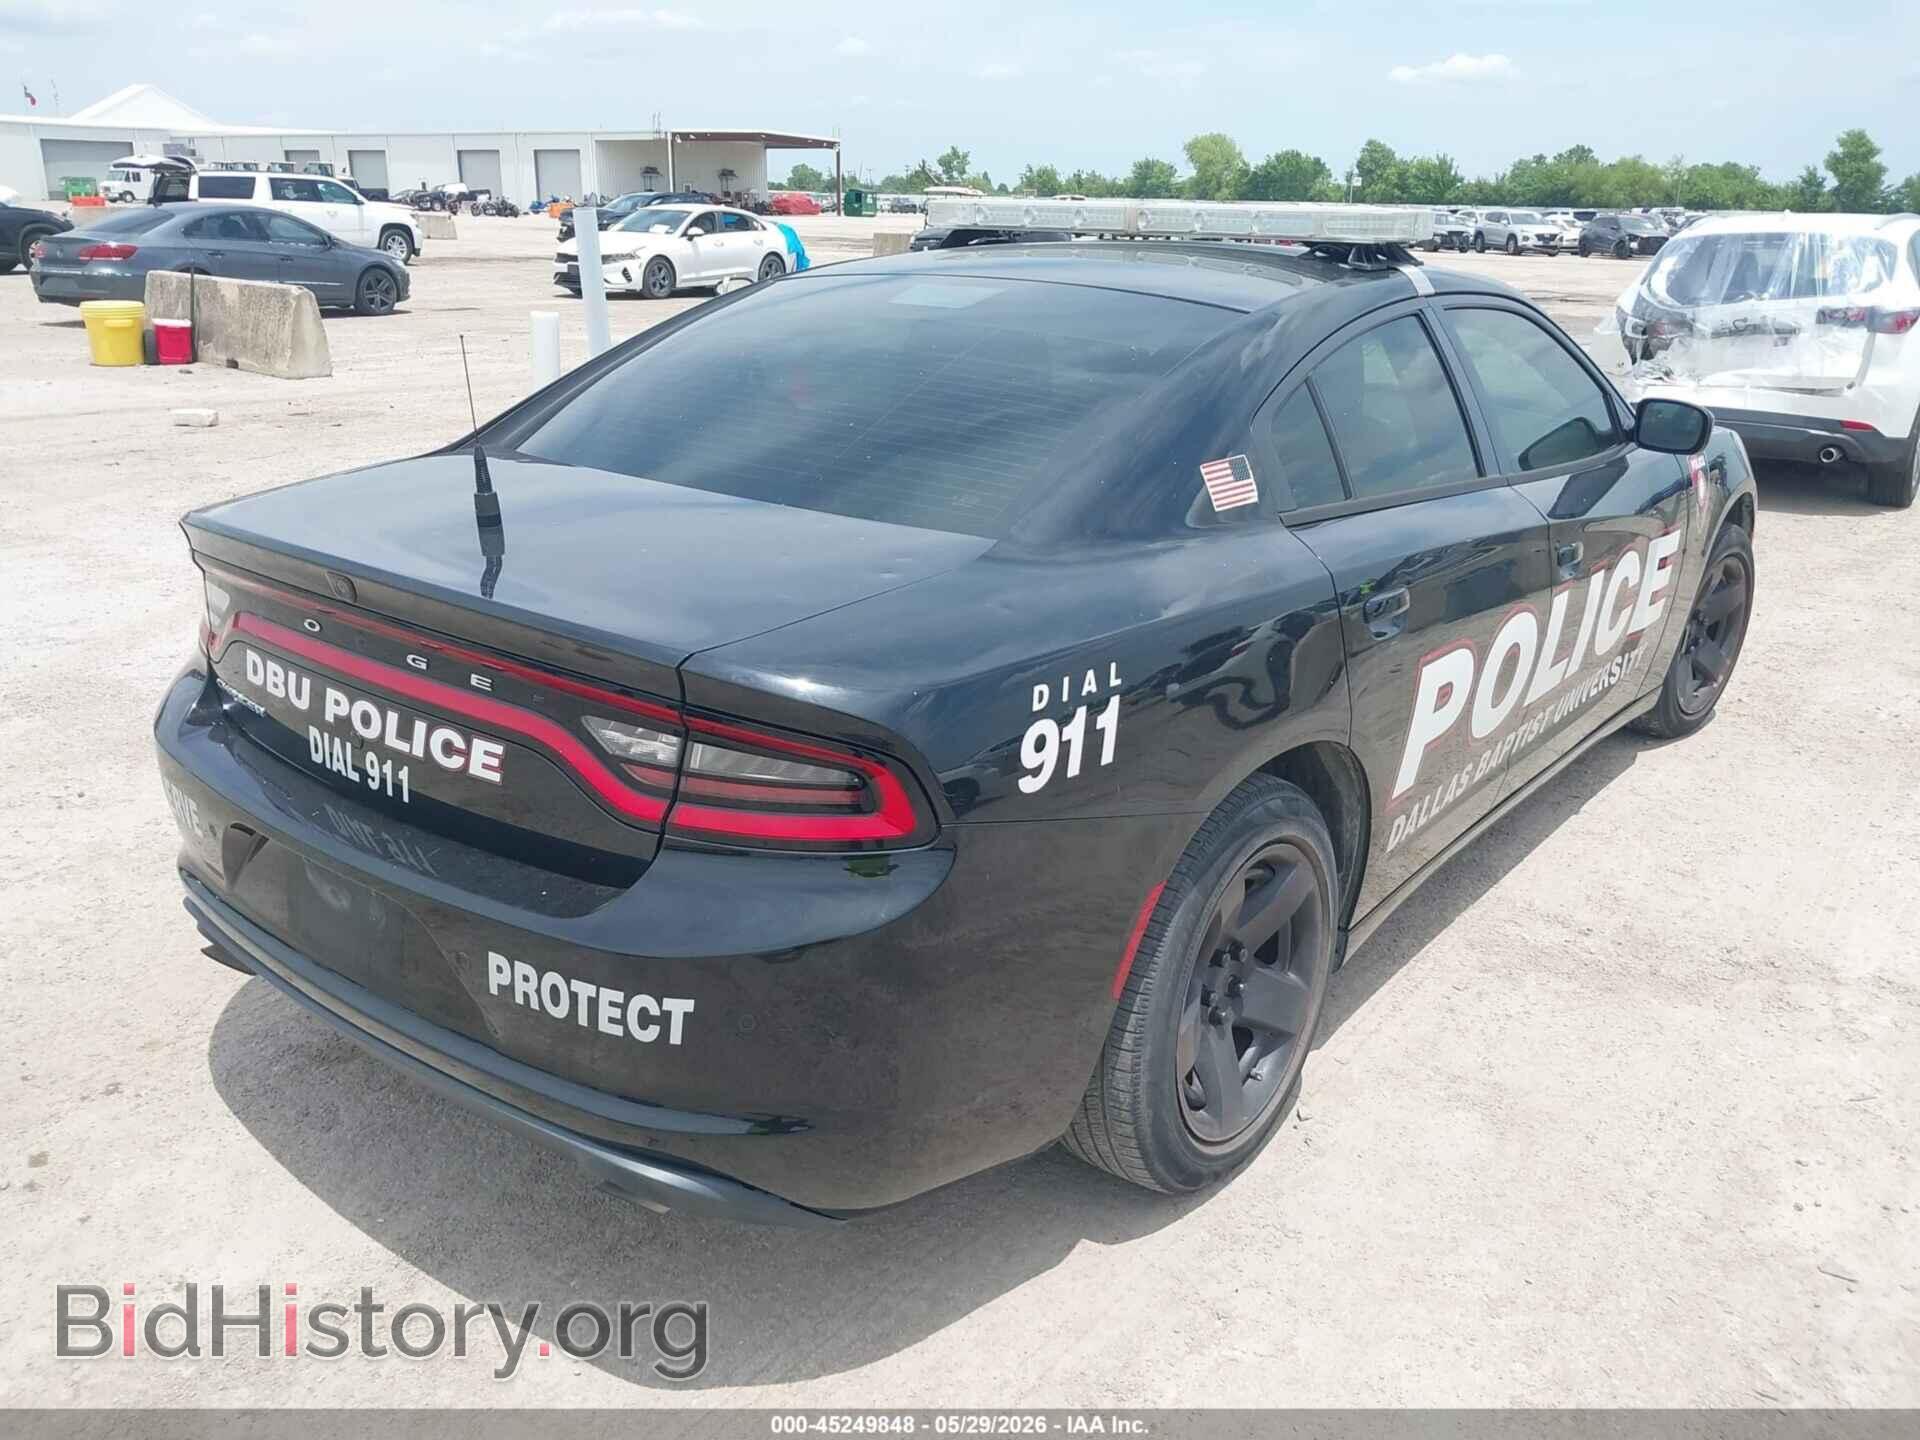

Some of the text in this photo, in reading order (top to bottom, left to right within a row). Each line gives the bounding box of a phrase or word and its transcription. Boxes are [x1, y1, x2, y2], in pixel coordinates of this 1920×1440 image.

[1032, 661, 1122, 712] DIAL
[1391, 528, 1681, 800] POLICE
[246, 649, 311, 710] DBU
[324, 687, 504, 784] POLICE
[308, 725, 410, 804] DIAL 911
[1018, 694, 1120, 794] 911
[1385, 762, 1473, 854] DALLAS
[1473, 705, 1555, 785] BAPTIST
[487, 951, 695, 1045] PROTECT
